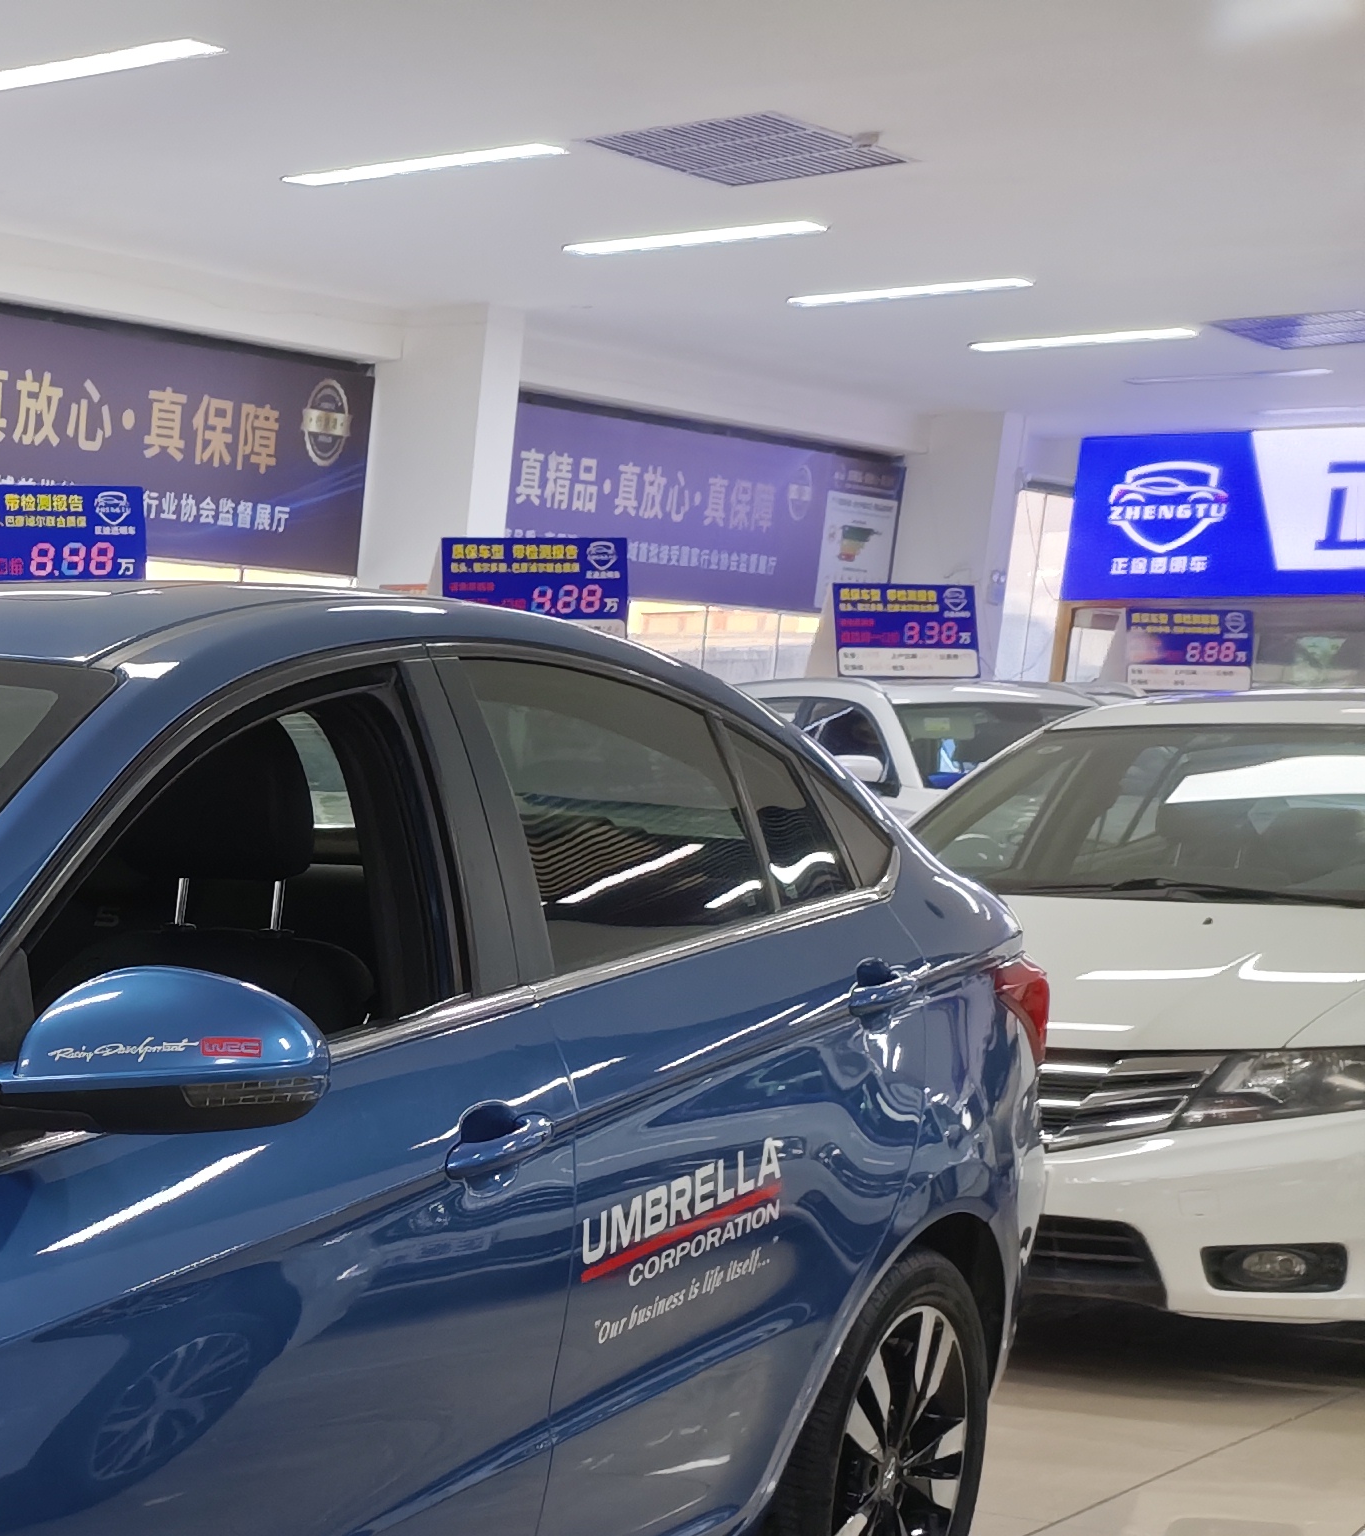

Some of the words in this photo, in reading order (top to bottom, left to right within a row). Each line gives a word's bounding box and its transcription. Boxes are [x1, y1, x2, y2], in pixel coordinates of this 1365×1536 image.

[4, 493, 84, 512] 带检测报告
[1109, 502, 1228, 521] ZHENGTU
[582, 1137, 782, 1265] UMBRELLA
[628, 1199, 780, 1287] CORPORATION
[629, 1288, 686, 1332] business
[687, 1280, 701, 1302] is
[702, 1266, 725, 1298] life
